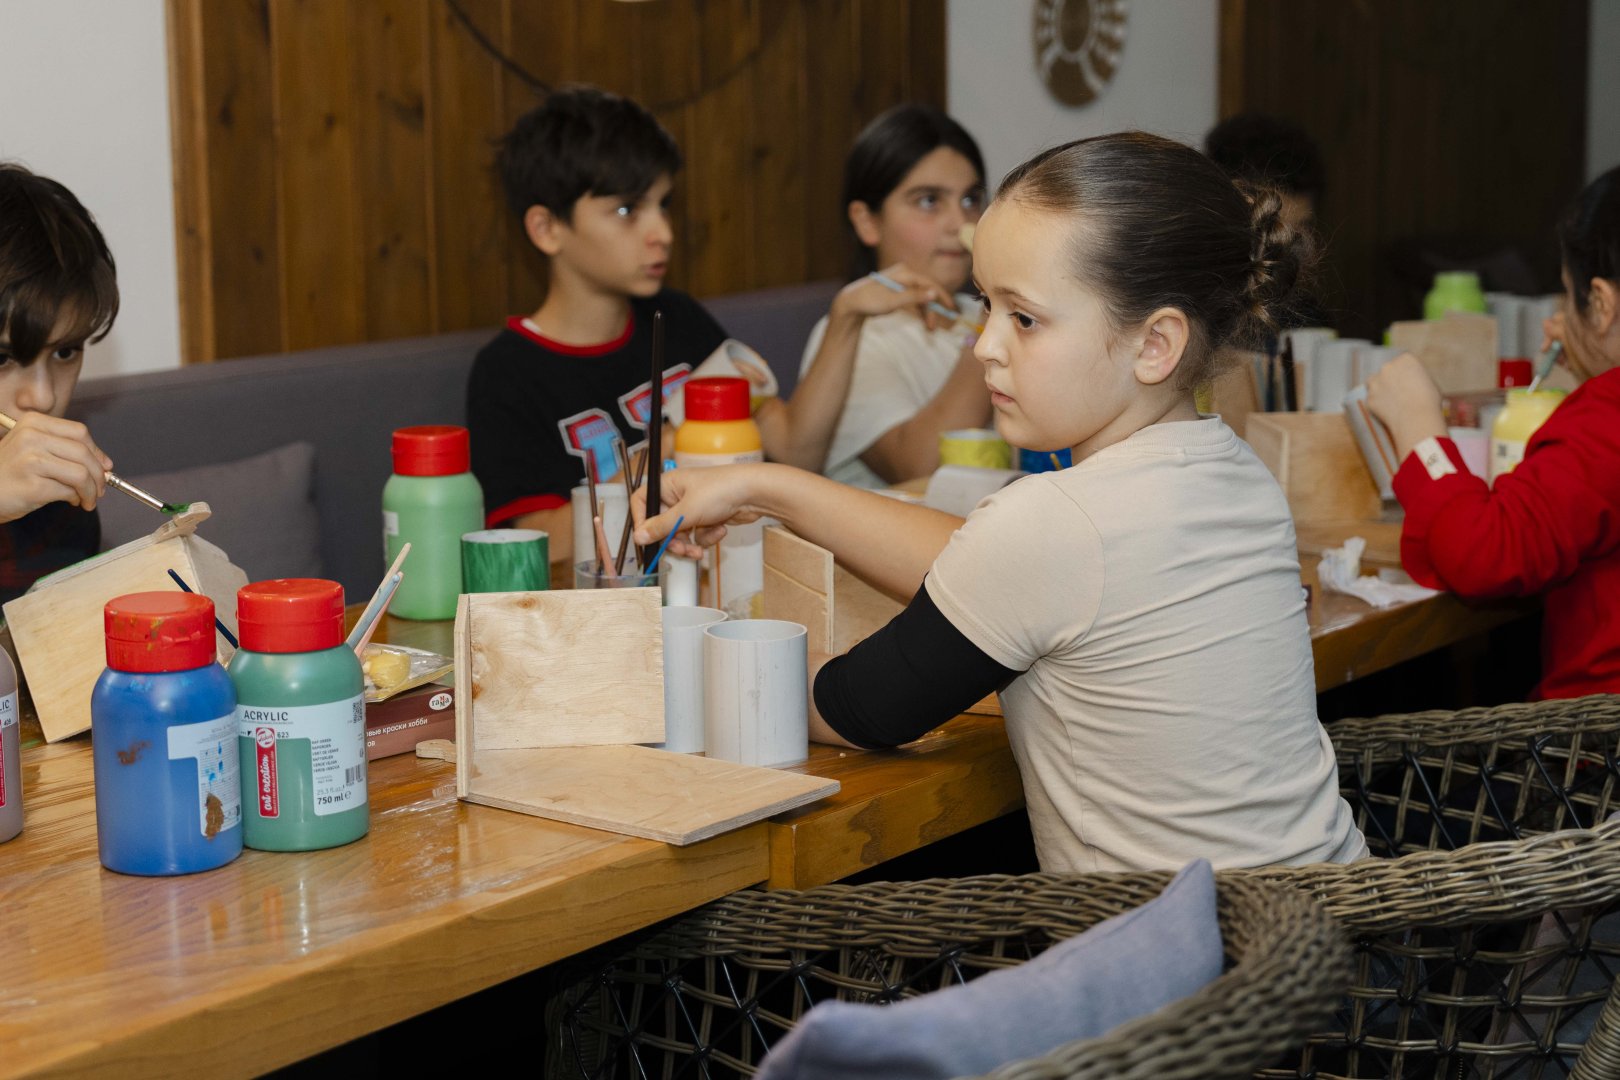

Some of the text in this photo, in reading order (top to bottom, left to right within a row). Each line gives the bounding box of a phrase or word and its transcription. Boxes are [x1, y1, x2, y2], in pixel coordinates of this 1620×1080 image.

[244, 710, 289, 721] ACRYLIC
[382, 723, 407, 735] краски
[408, 718, 428, 728] хобби
[277, 731, 289, 739] 623
[260, 754, 271, 793] creation
[261, 794, 272, 811] art
[317, 792, 343, 805] 750 ml
